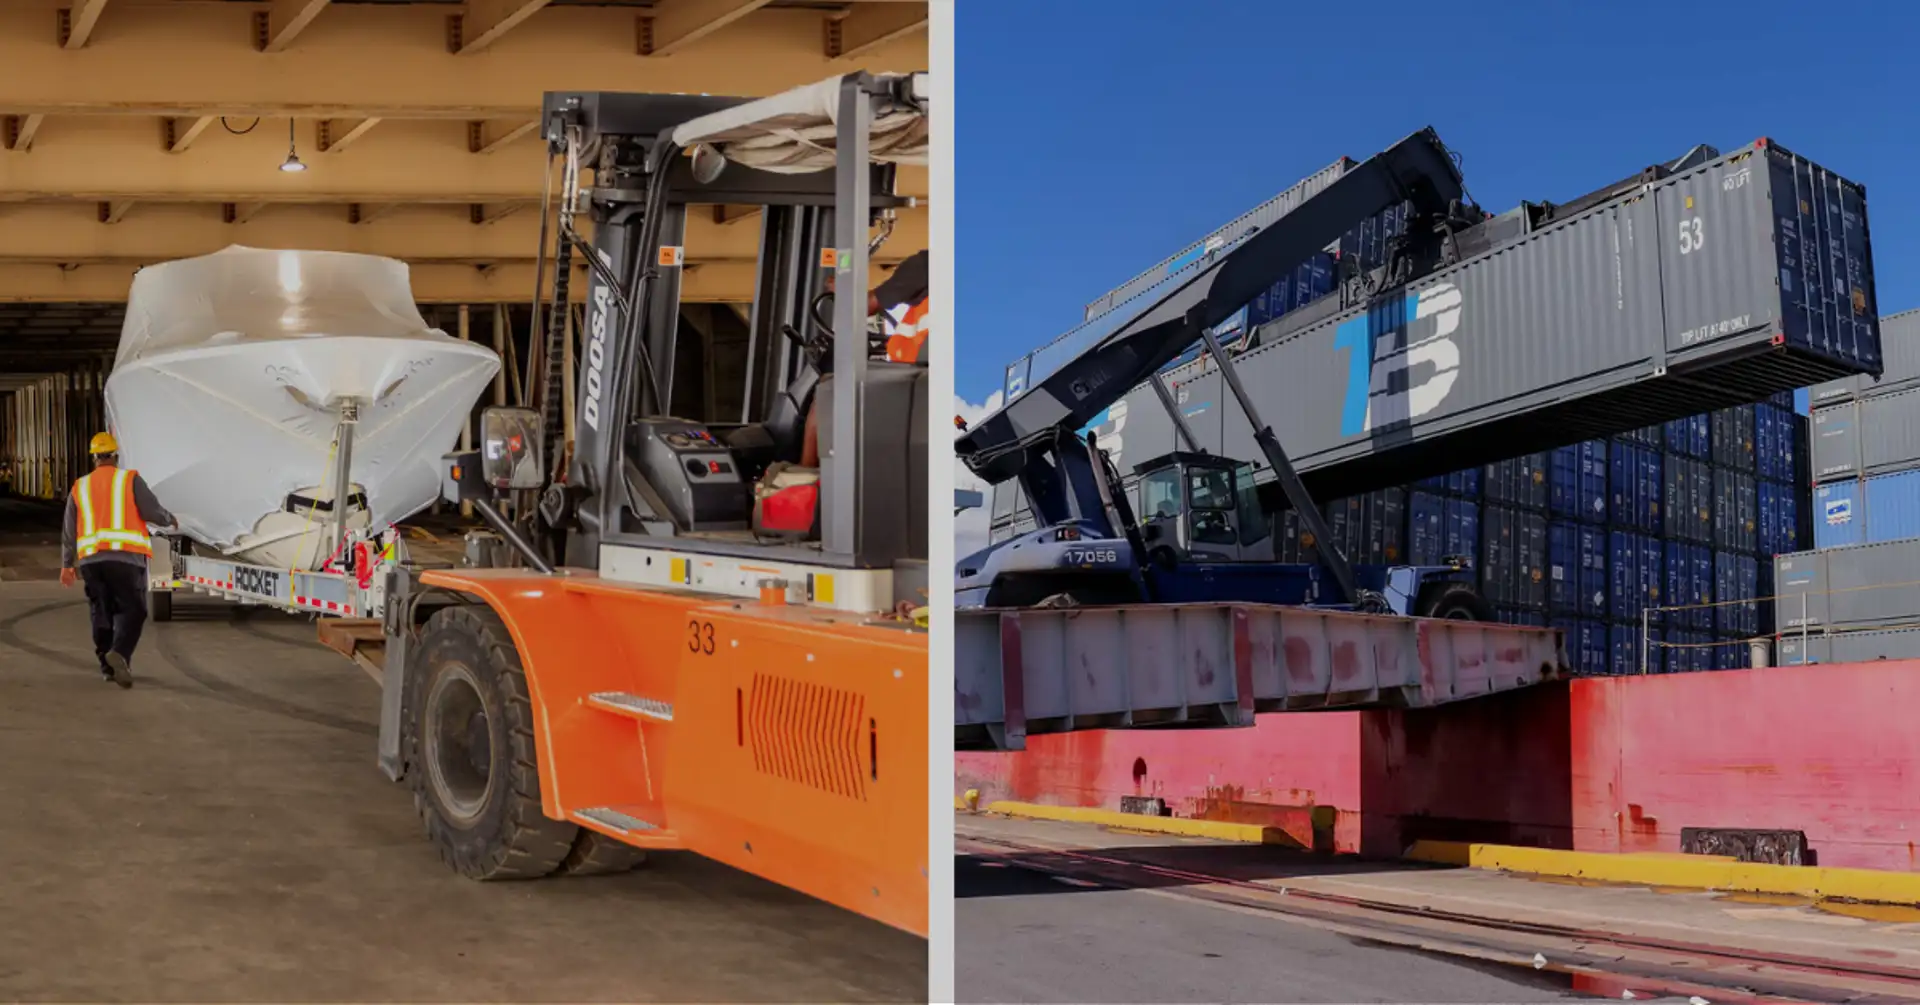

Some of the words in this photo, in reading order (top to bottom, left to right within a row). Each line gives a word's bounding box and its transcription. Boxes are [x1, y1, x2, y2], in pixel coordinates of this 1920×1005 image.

[1678, 215, 1704, 255] 53
[1065, 550, 1117, 564] 17056
[235, 565, 280, 598] ROCKET
[688, 620, 716, 656] 33
